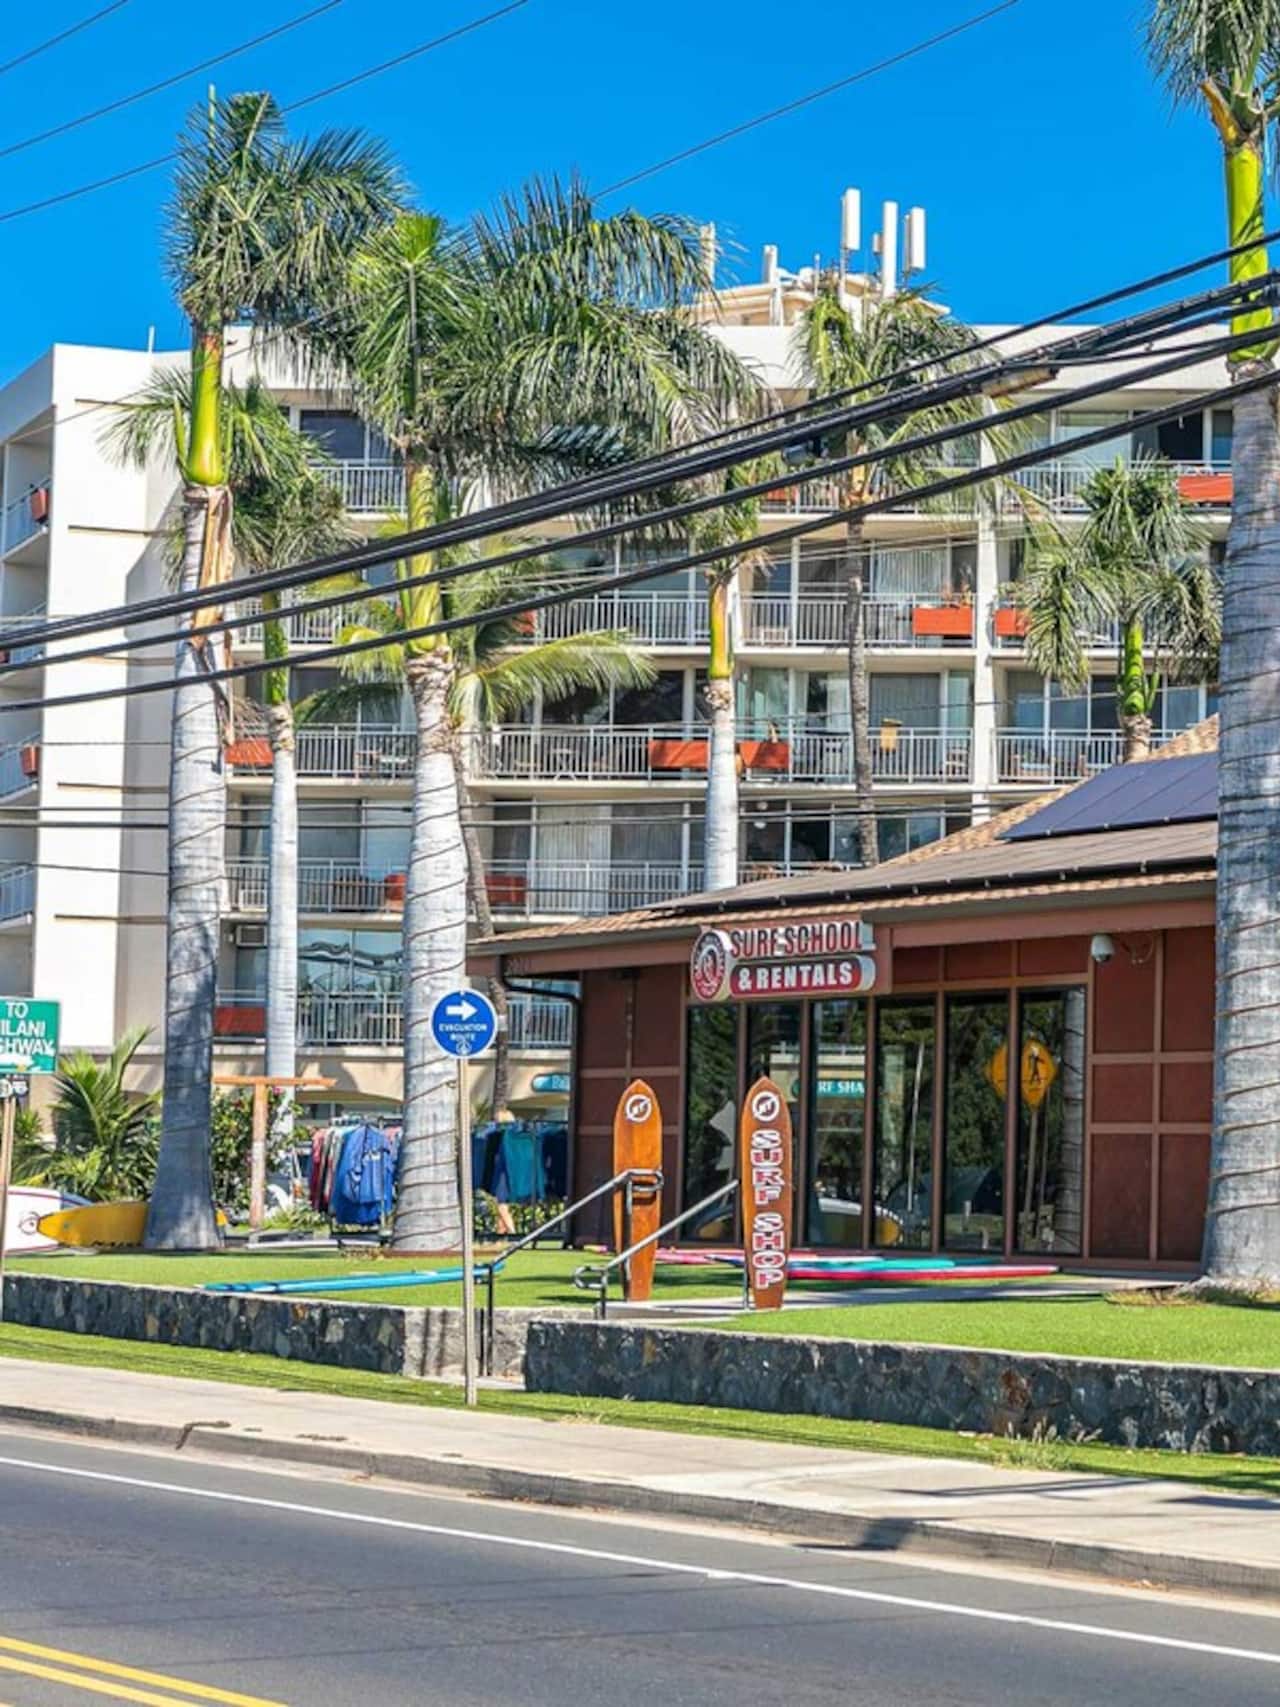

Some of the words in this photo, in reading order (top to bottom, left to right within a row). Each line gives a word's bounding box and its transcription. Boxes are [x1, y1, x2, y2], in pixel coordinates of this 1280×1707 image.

[730, 929, 780, 959] SURF
[783, 921, 864, 956] SCHOOL
[738, 966, 752, 991] &
[756, 962, 853, 990] RENTALS
[6, 1002, 28, 1018] TO
[750, 1129, 785, 1205] SURF
[752, 1212, 786, 1290] SHOP
